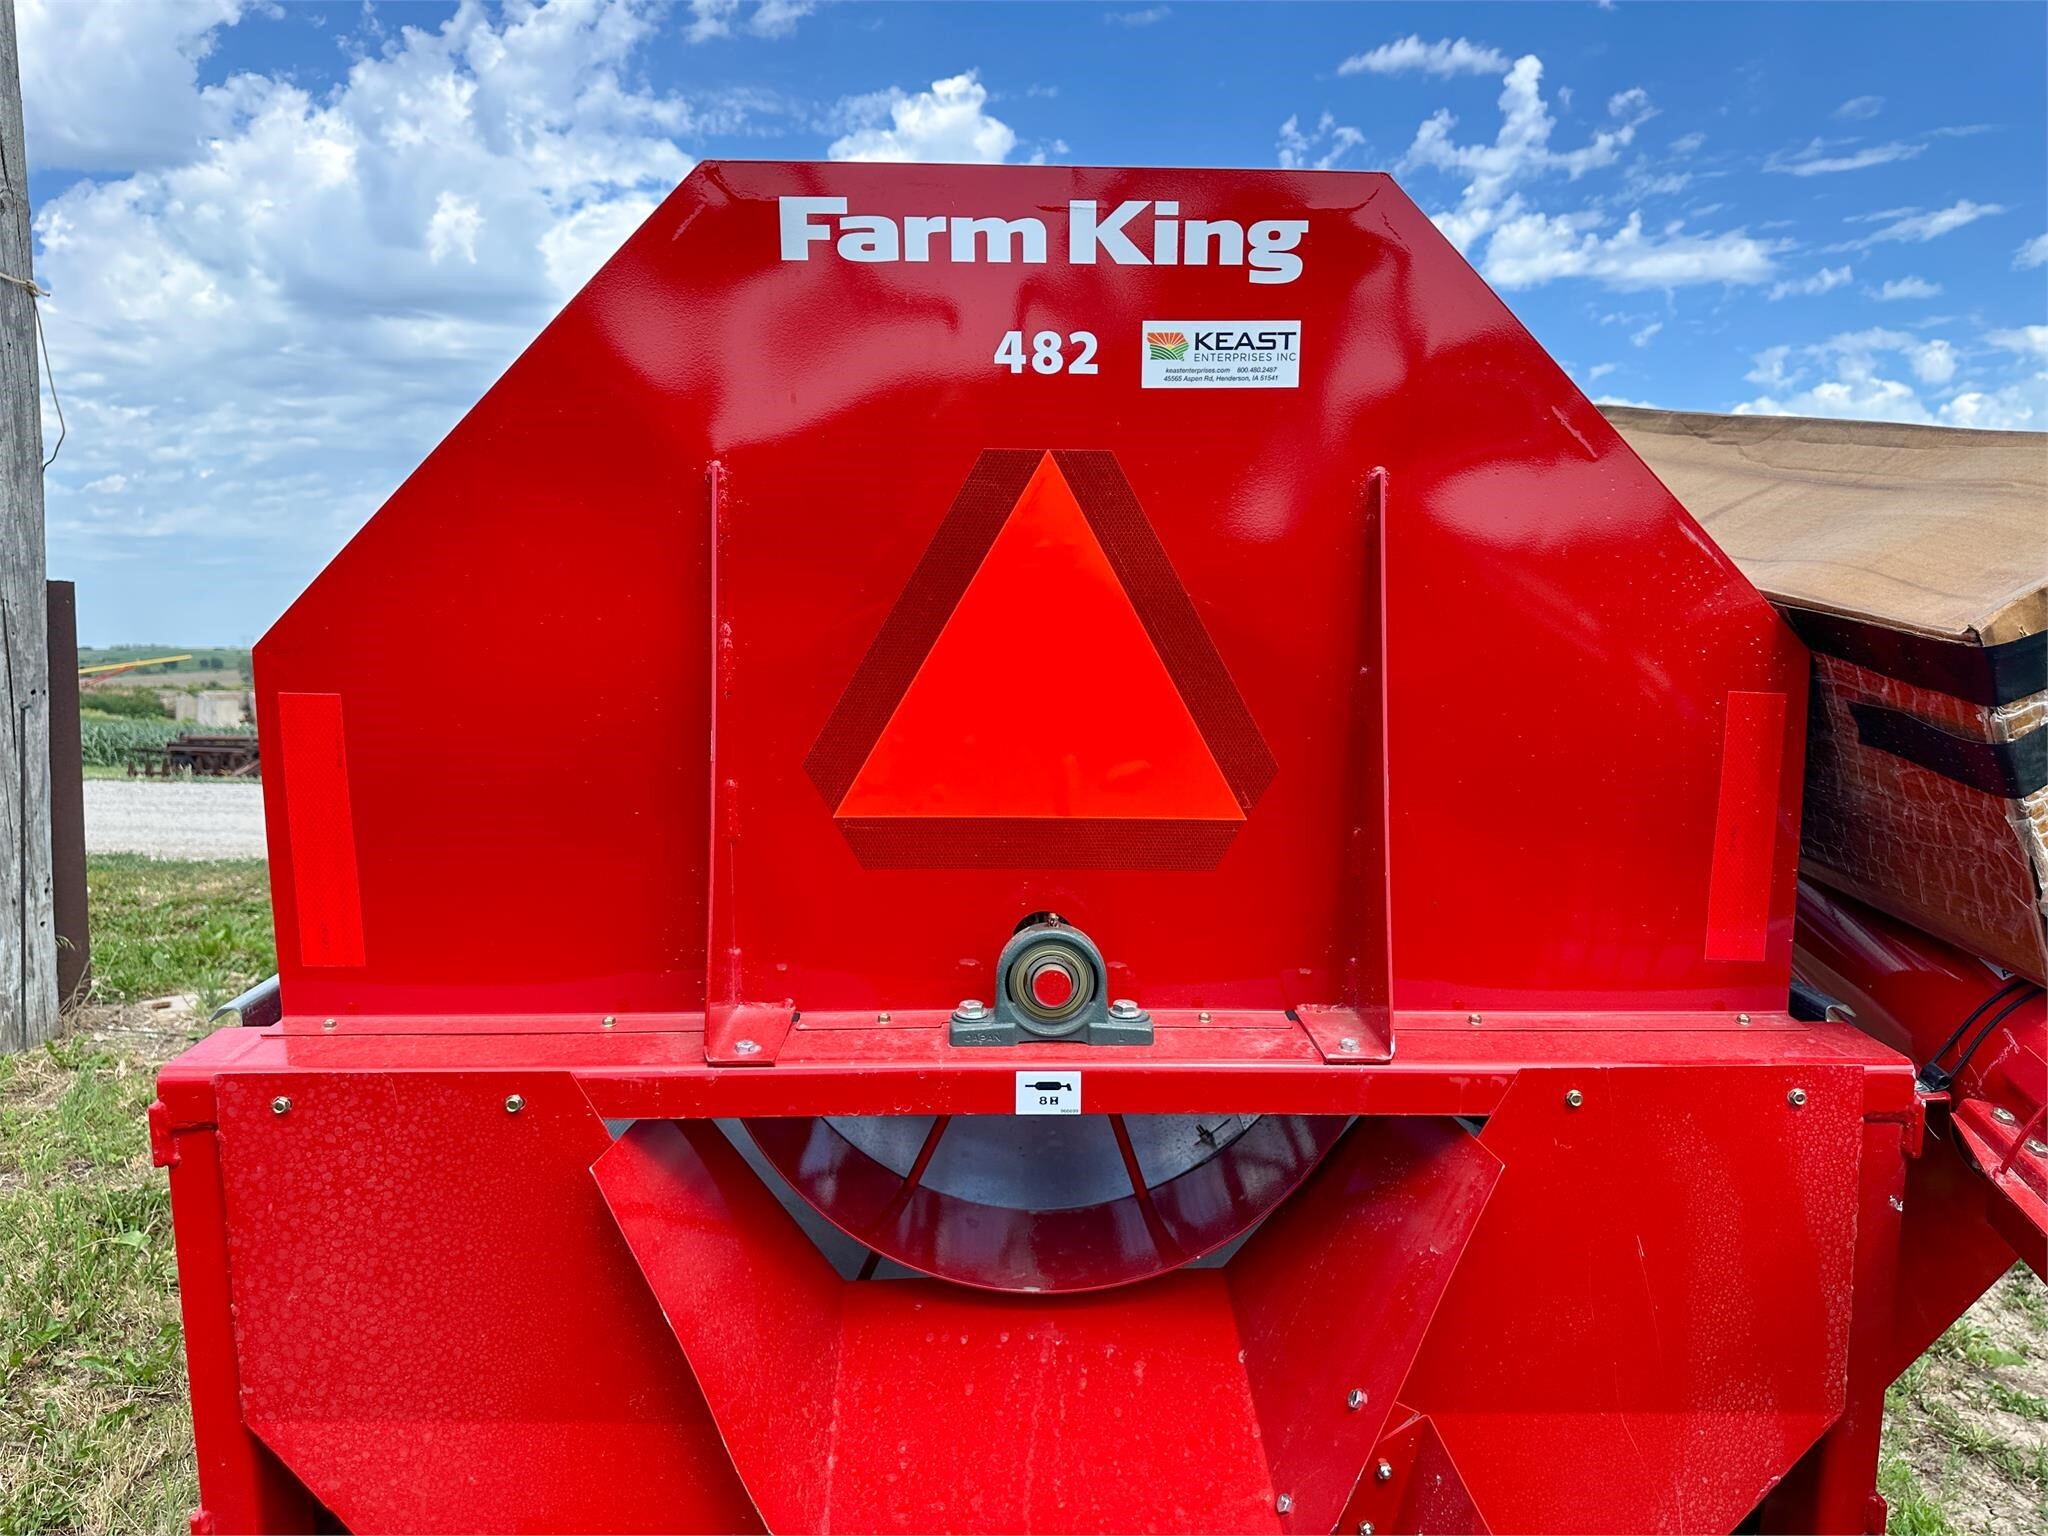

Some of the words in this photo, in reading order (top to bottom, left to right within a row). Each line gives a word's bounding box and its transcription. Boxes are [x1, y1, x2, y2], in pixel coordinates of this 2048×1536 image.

[779, 196, 1047, 263] Farm
[1069, 200, 1309, 284] King
[1195, 332, 1297, 350] KEAST
[994, 331, 1099, 375] 482
[1194, 353, 1272, 362] ENTERPRISES
[1277, 352, 1297, 361] INC
[1165, 367, 1231, 375] keastenterprises.com
